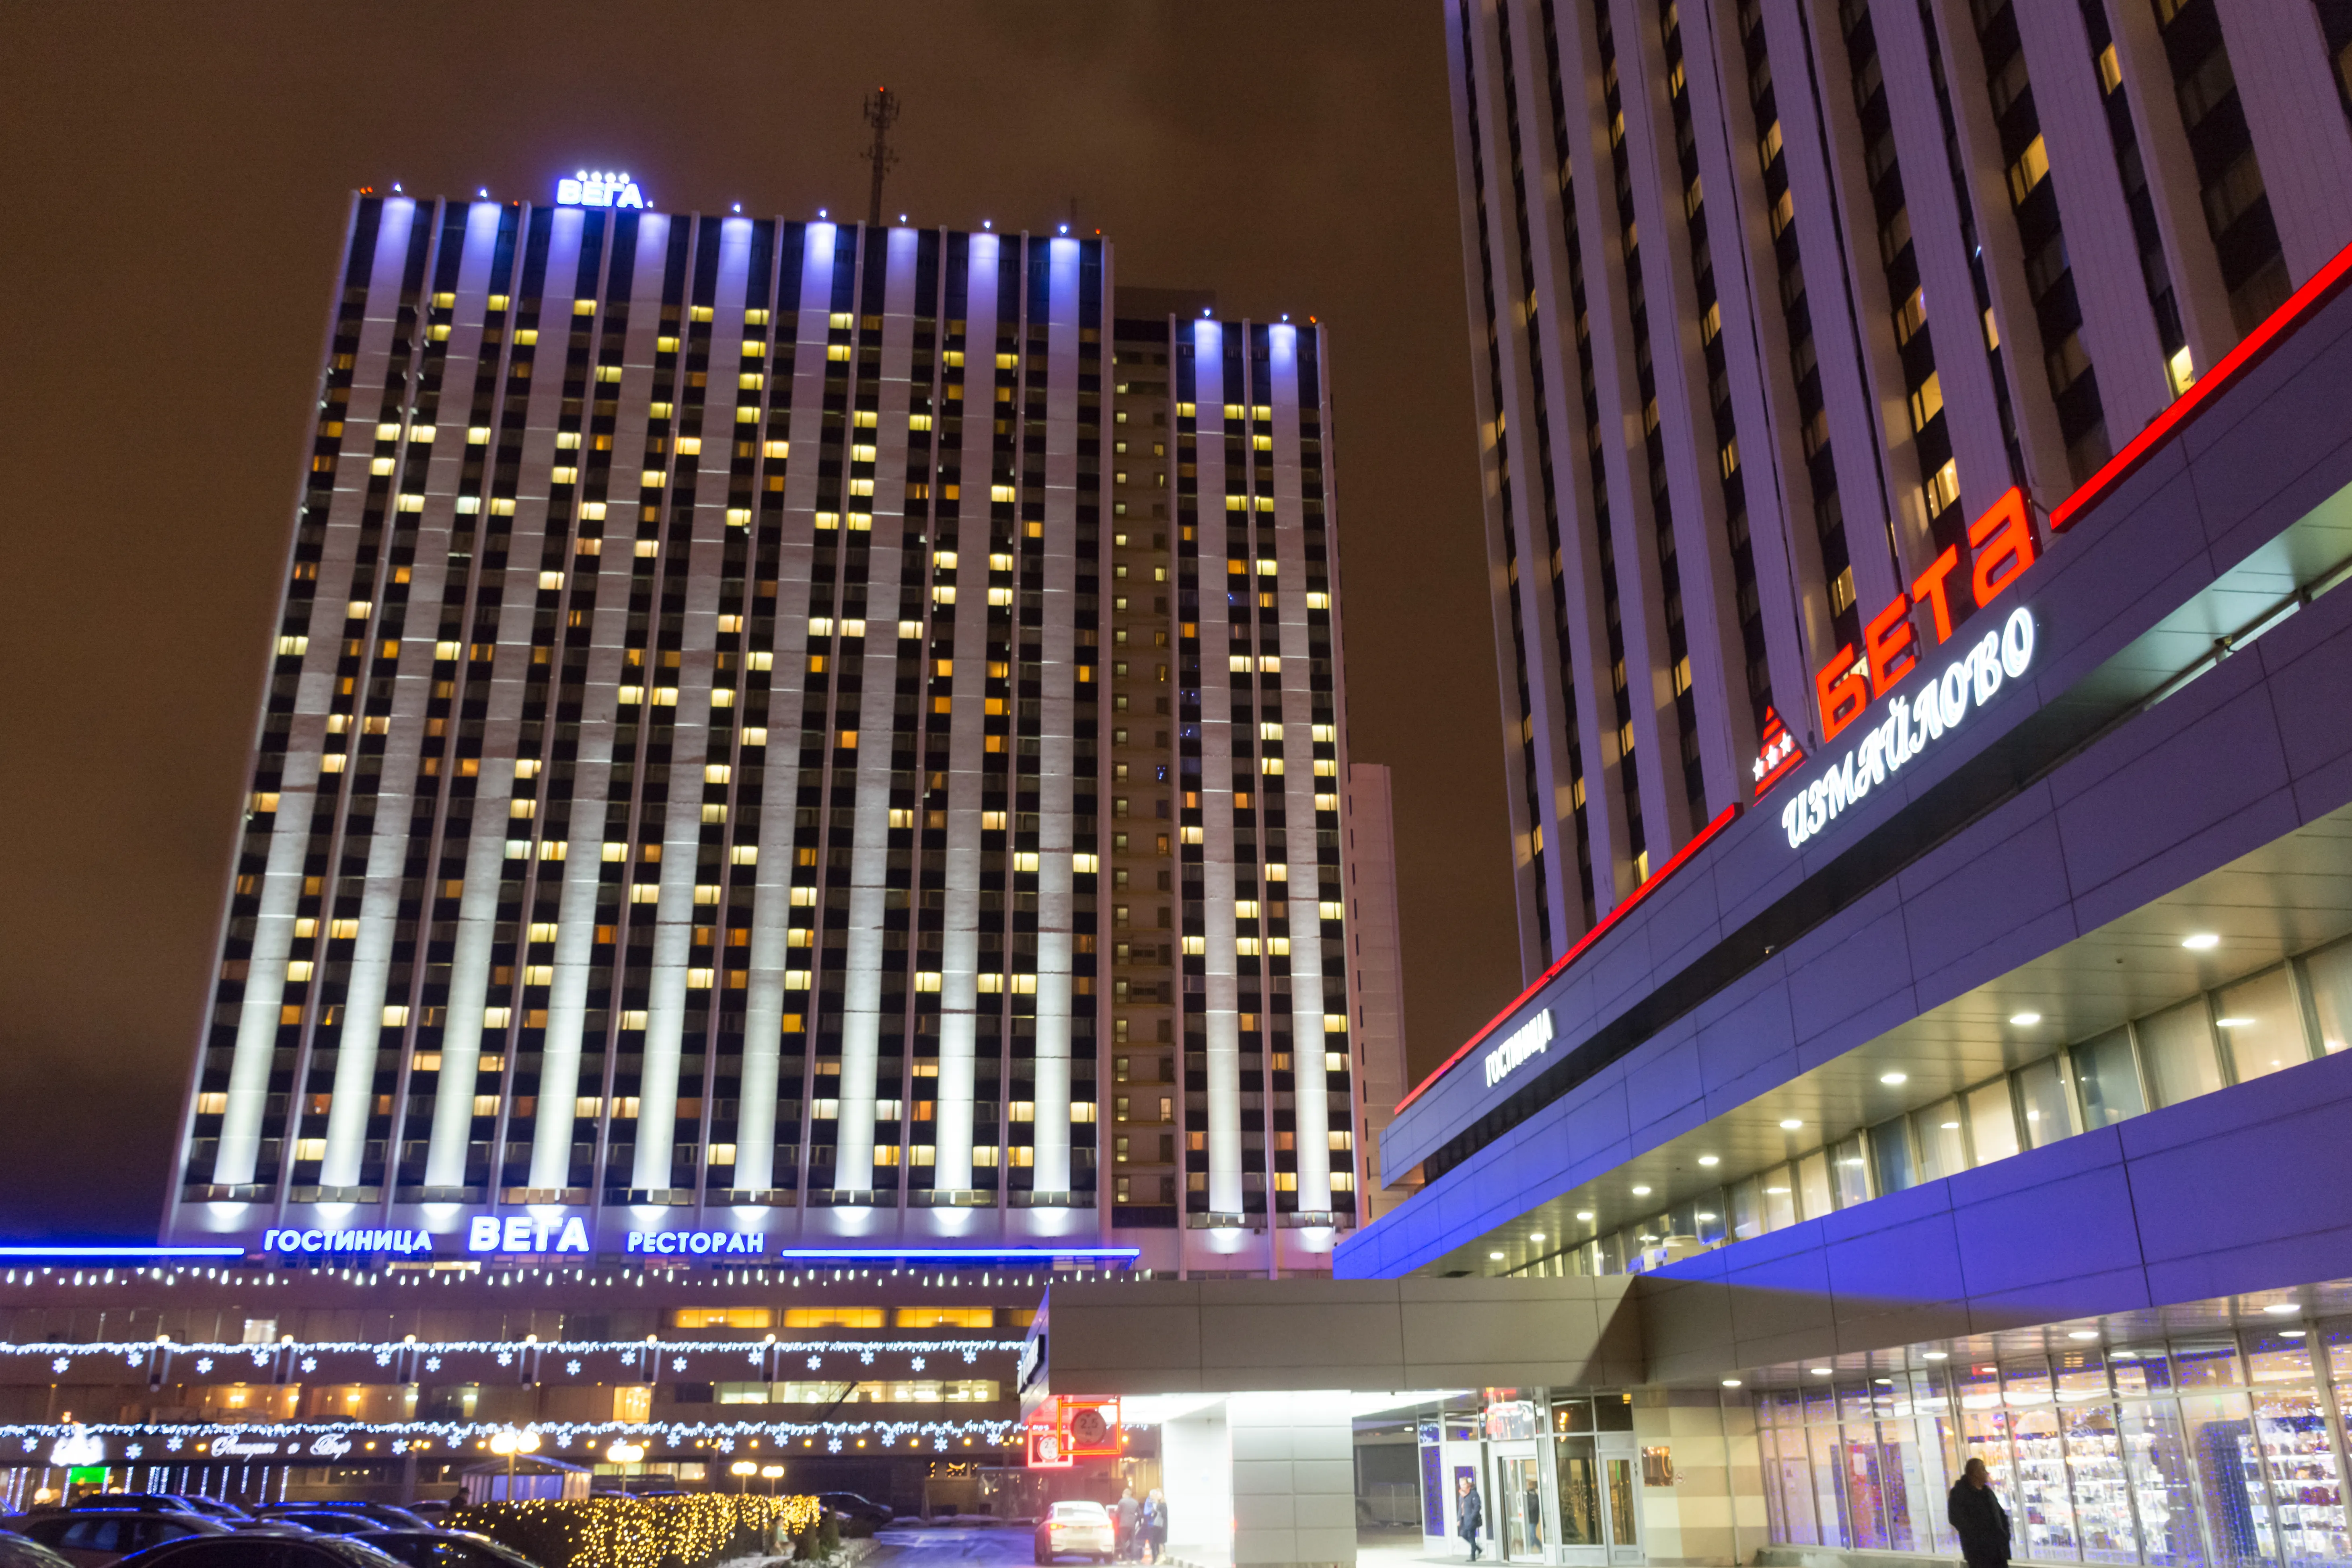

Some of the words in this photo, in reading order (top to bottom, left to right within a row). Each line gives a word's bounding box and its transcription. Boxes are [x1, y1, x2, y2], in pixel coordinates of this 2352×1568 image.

[557, 179, 644, 209] ВЕГА
[264, 1230, 433, 1254] ГОСТИНИЦА
[469, 1216, 590, 1252] ВЕГА
[628, 1231, 764, 1254] РЕСТОРАН
